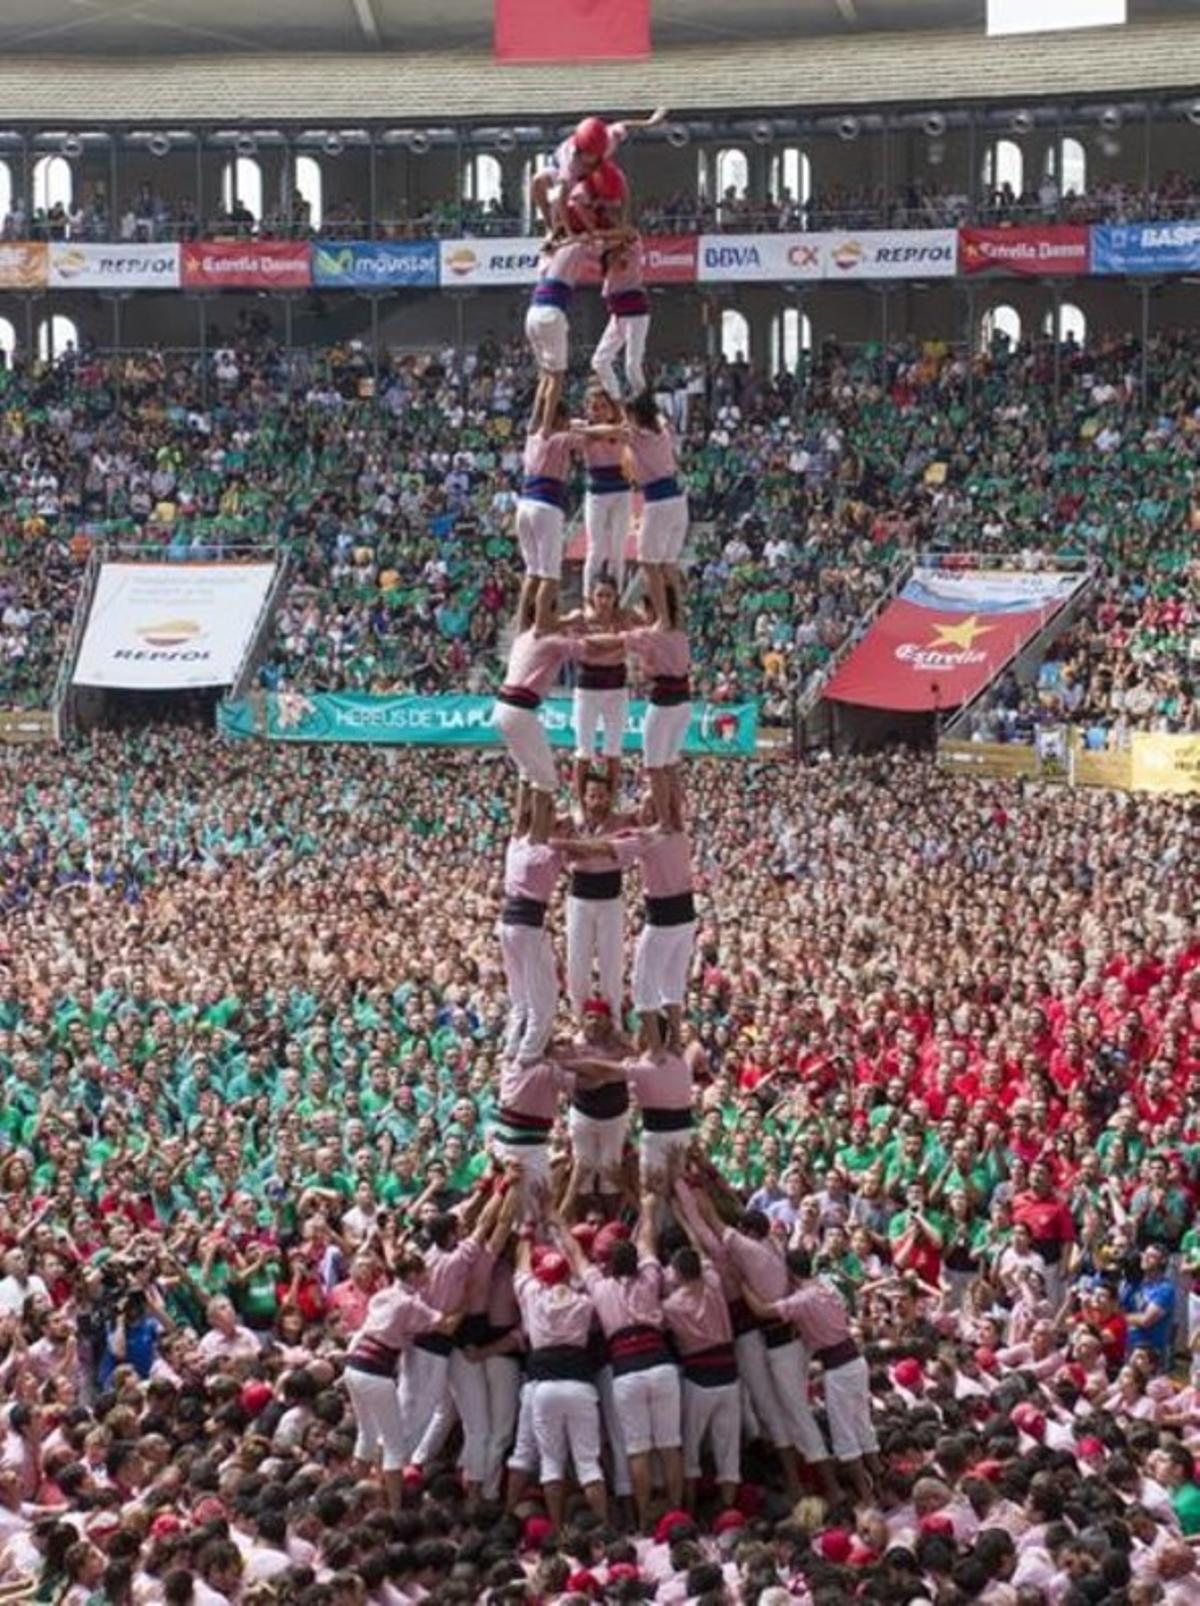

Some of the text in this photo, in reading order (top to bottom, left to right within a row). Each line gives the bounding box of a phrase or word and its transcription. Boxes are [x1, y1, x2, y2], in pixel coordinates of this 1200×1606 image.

[488, 254, 540, 269] REPS
[704, 247, 760, 268] BBVA
[787, 246, 818, 266] CX
[875, 246, 953, 263] REPSOL
[355, 255, 435, 272] movistar
